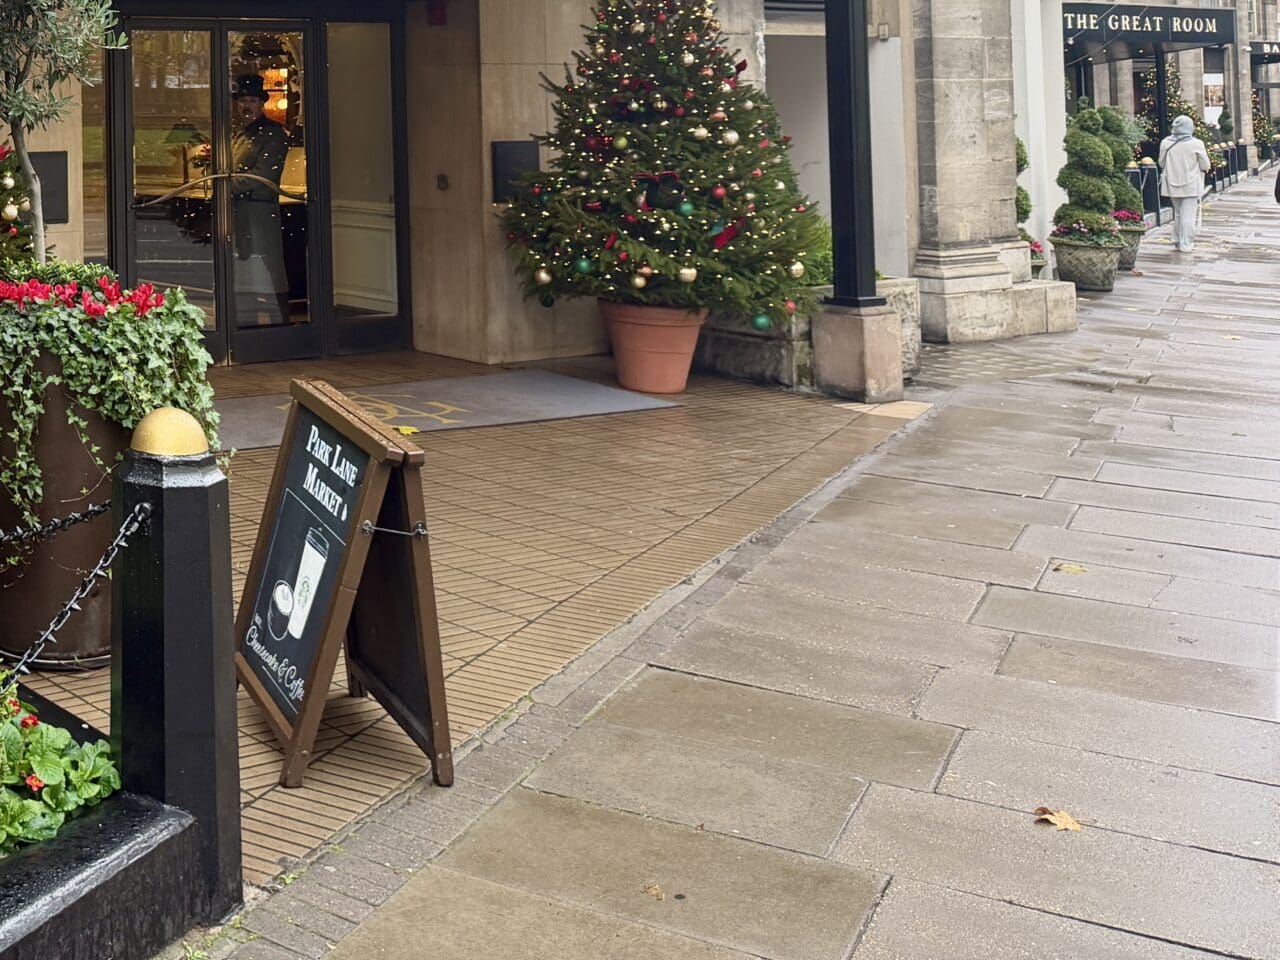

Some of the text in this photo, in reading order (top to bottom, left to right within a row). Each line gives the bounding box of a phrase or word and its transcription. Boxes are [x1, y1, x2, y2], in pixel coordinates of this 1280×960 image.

[1063, 13, 1217, 32] THE GREAT ROOM
[305, 424, 358, 487] PARK LANE
[302, 462, 343, 517] MARKET
